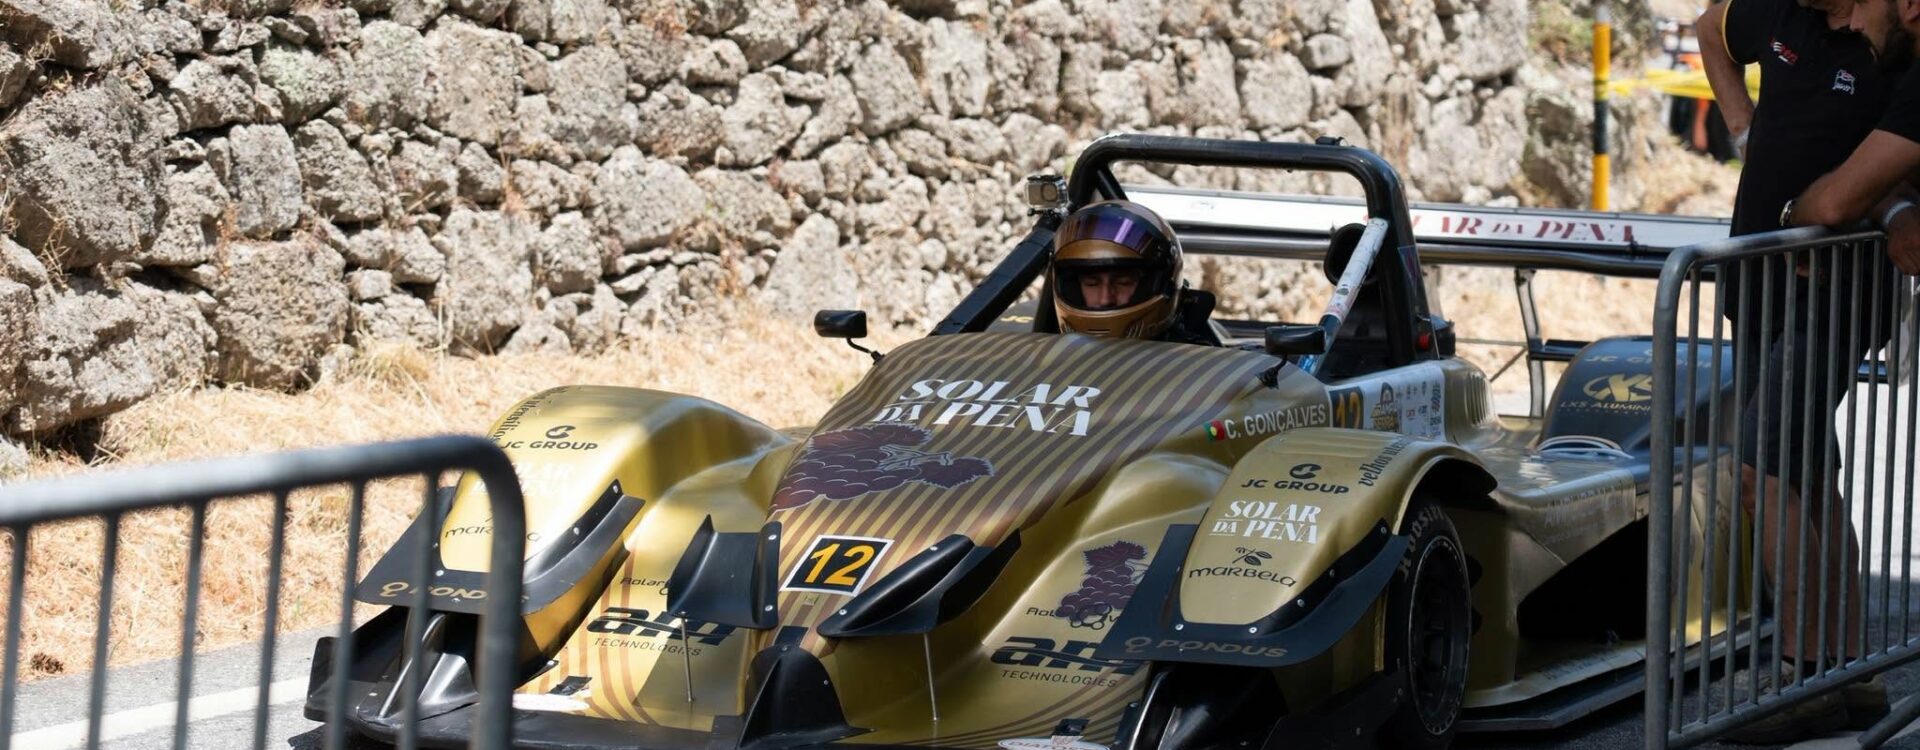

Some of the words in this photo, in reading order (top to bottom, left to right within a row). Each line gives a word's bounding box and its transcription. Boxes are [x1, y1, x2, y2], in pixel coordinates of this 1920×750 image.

[900, 379, 1101, 408] SOLAR
[872, 404, 922, 422] DA
[932, 402, 1091, 436] PENA
[1224, 419, 1241, 440] C.
[1244, 403, 1327, 437] GONÇALVES
[1334, 389, 1362, 430] 12
[501, 441, 524, 449] JC
[529, 441, 598, 451] GROUP
[1241, 479, 1268, 488] JC
[1274, 480, 1350, 494] GROUP
[1224, 500, 1321, 523] SOLAR
[1211, 521, 1238, 534] DA
[1242, 520, 1318, 544] PENA
[804, 543, 875, 586] 12
[1156, 639, 1289, 657] PONDUS
[1002, 670, 1118, 688] TECHNOLOGIES
